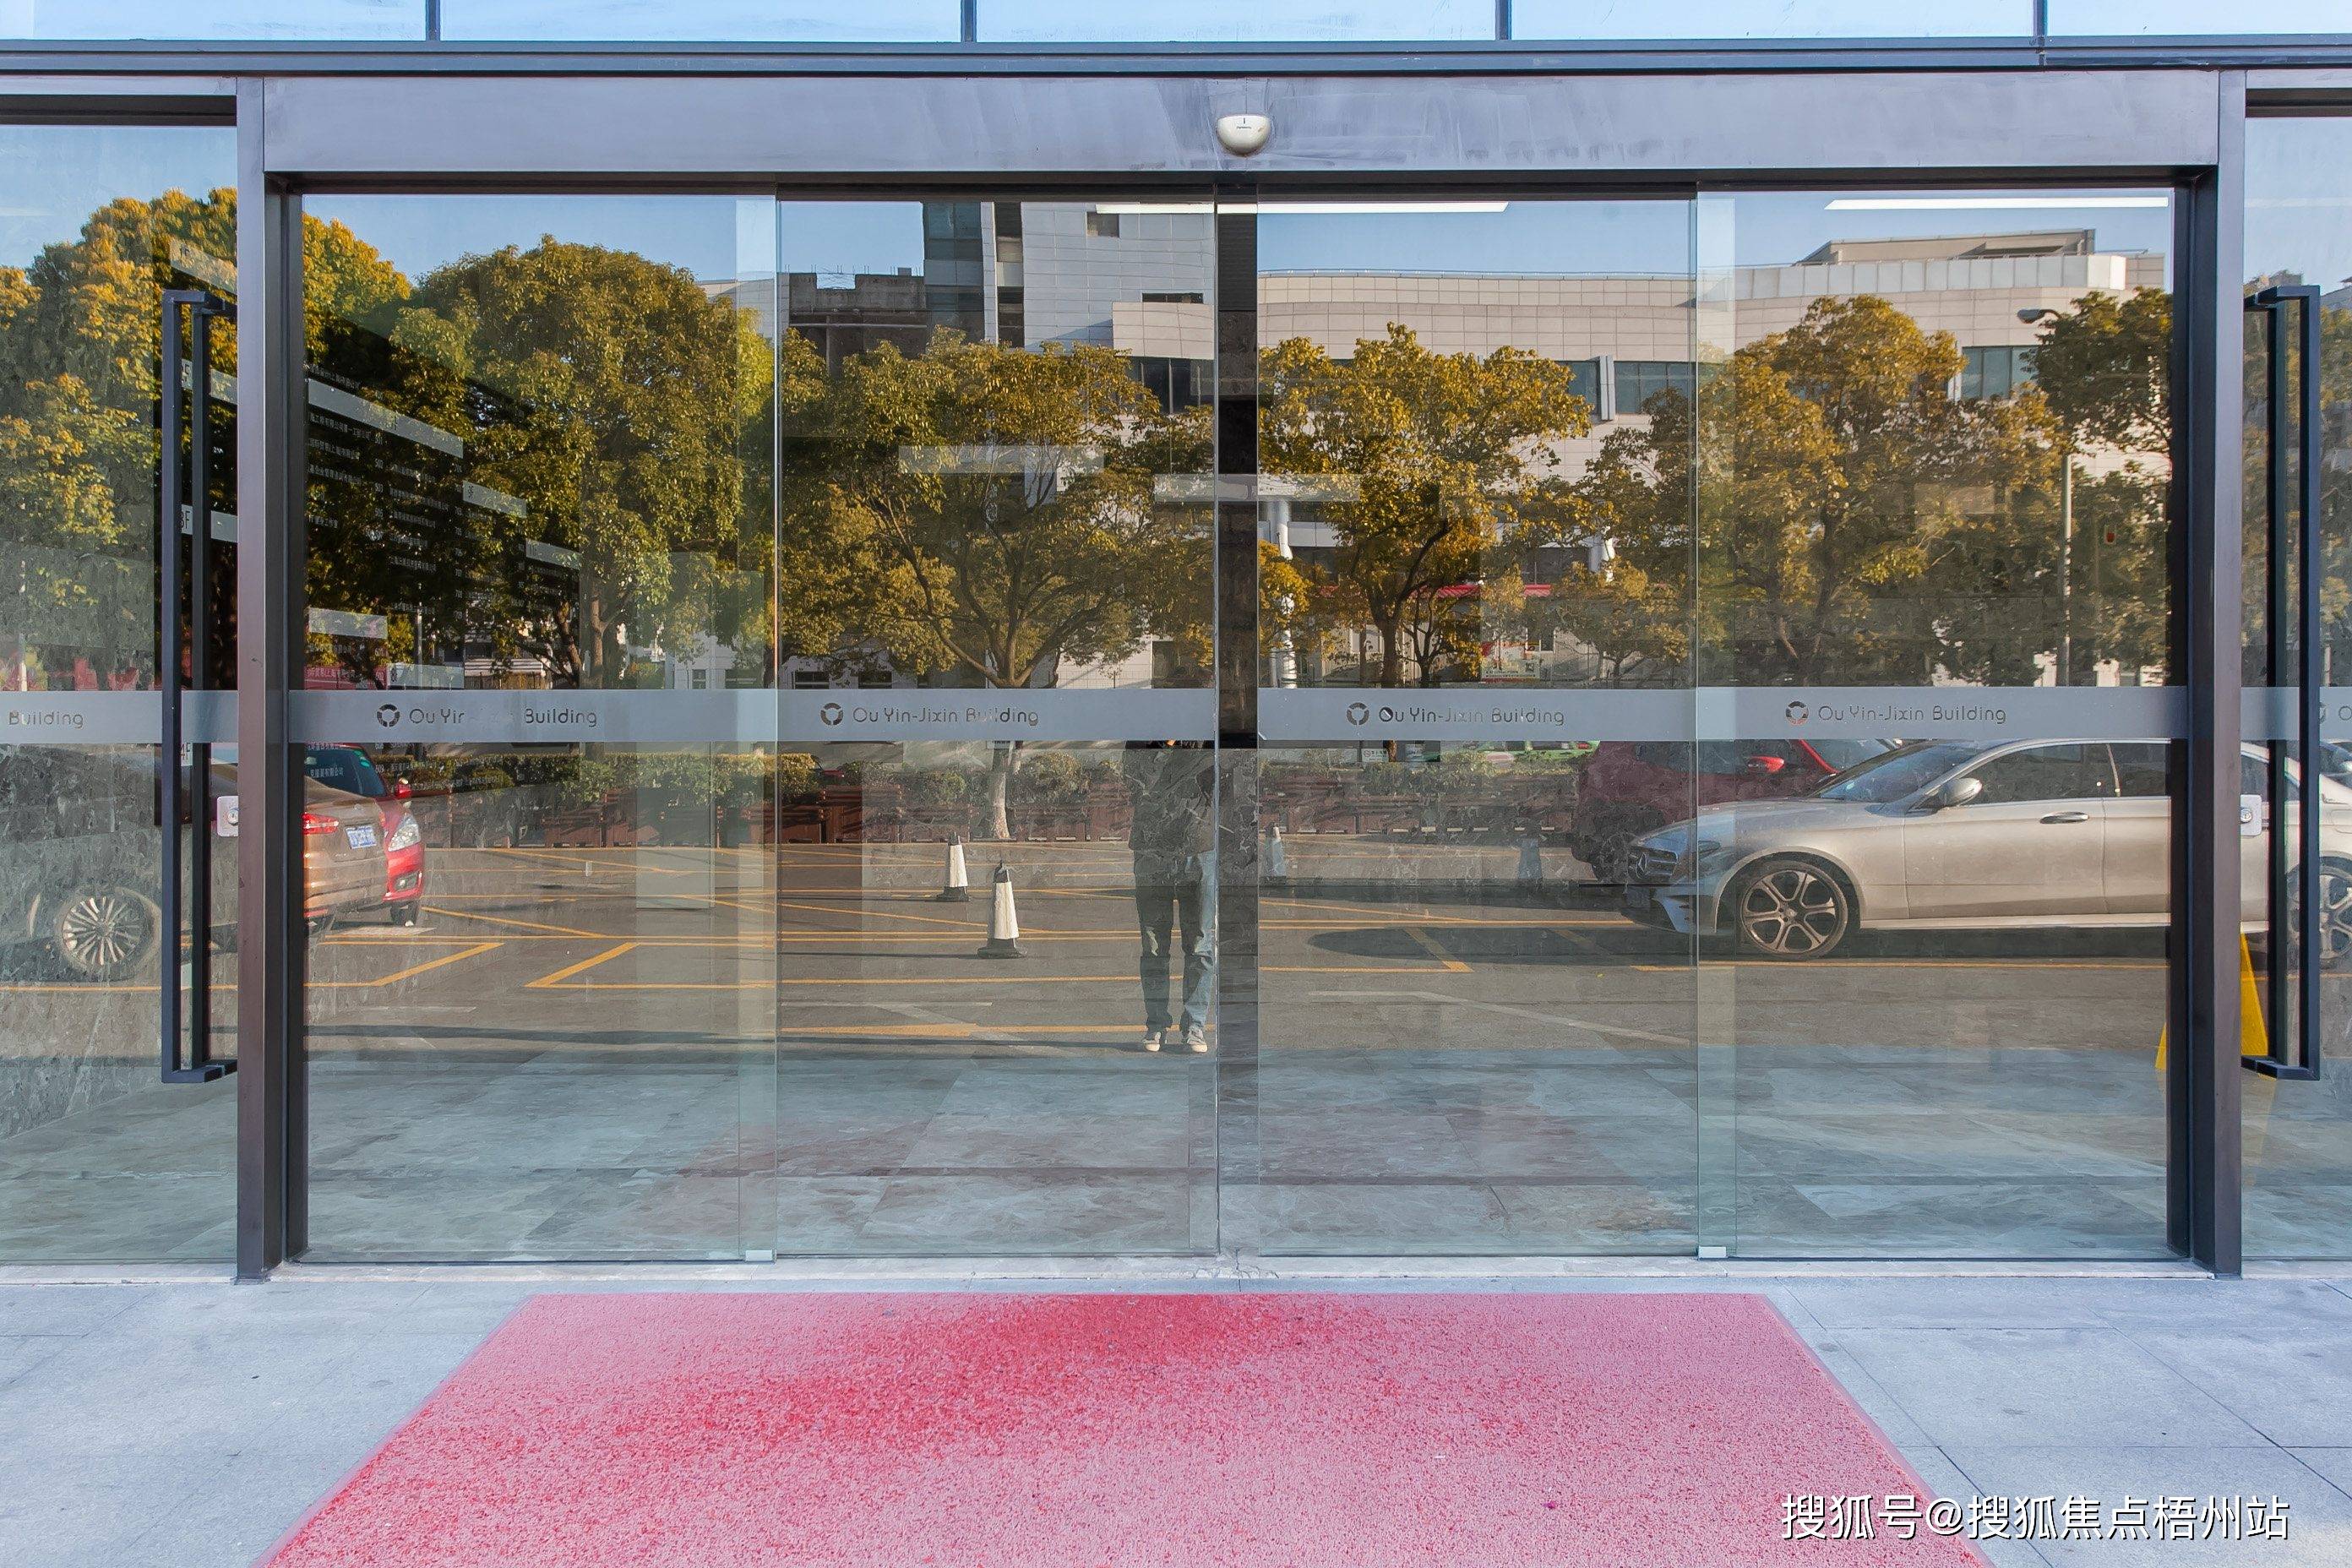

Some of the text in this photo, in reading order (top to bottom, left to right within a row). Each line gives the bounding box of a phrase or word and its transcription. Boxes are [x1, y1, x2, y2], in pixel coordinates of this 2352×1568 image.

[8, 711, 84, 729] Building
[409, 708, 435, 724] Ou
[525, 708, 597, 727] Building
[852, 707, 879, 722] Ou
[884, 707, 958, 722] Yin-Jixin
[1379, 706, 1565, 727] Ou Yin-Jixin Building
[1818, 705, 2006, 724] Ou Yin-Jixin Building
